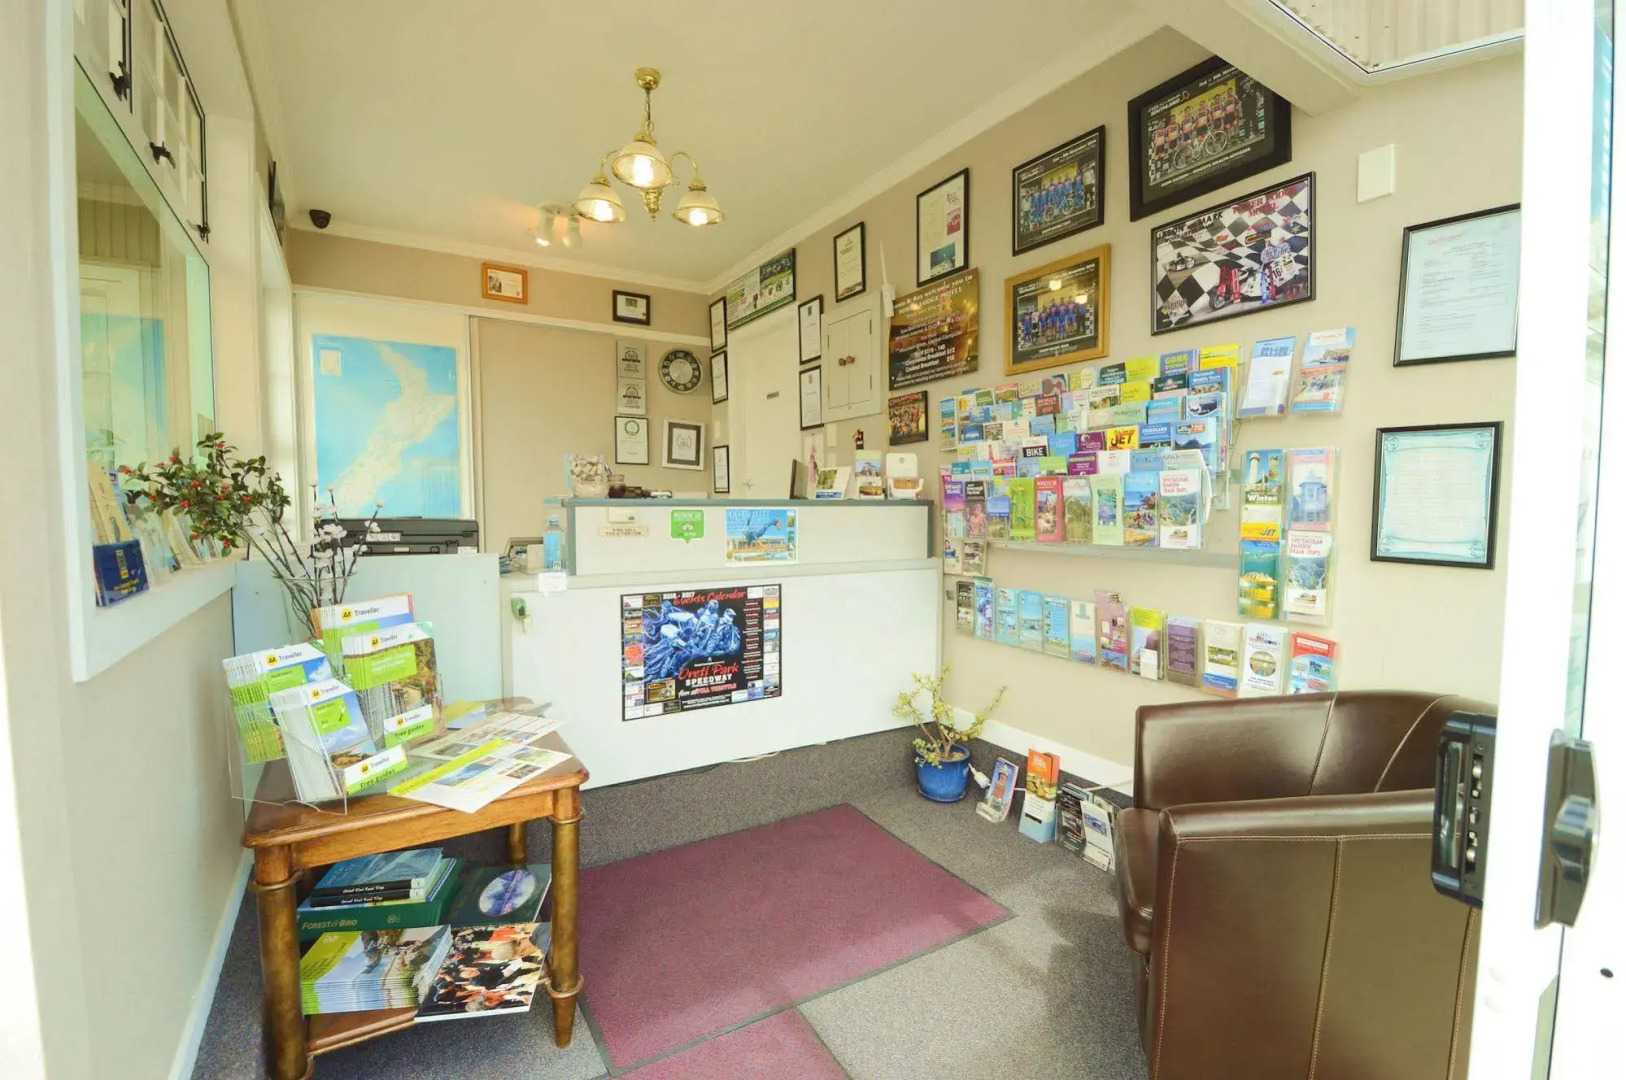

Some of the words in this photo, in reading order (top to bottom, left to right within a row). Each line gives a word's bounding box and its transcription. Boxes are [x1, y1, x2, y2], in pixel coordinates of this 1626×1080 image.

[924, 284, 950, 297] welcome
[952, 279, 963, 288] you
[927, 350, 946, 360] Breakfast
[921, 360, 940, 368] Breakfast
[890, 393, 922, 406] CHAMPIONS
[1111, 432, 1134, 445] JET
[1026, 448, 1044, 456] BIKE
[673, 594, 705, 605] Events
[707, 588, 746, 601] Calendar
[354, 607, 380, 616] Traveller
[380, 634, 398, 642] Traveller
[278, 652, 302, 660] Traveller
[678, 666, 708, 680] Oreti
[712, 662, 738, 674] Park
[686, 674, 732, 686] SPEEDWAY
[408, 724, 424, 734] guides
[370, 757, 390, 768] Traveller
[361, 779, 374, 789] Free
[376, 769, 395, 782] guides
[302, 921, 331, 930] FOREST
